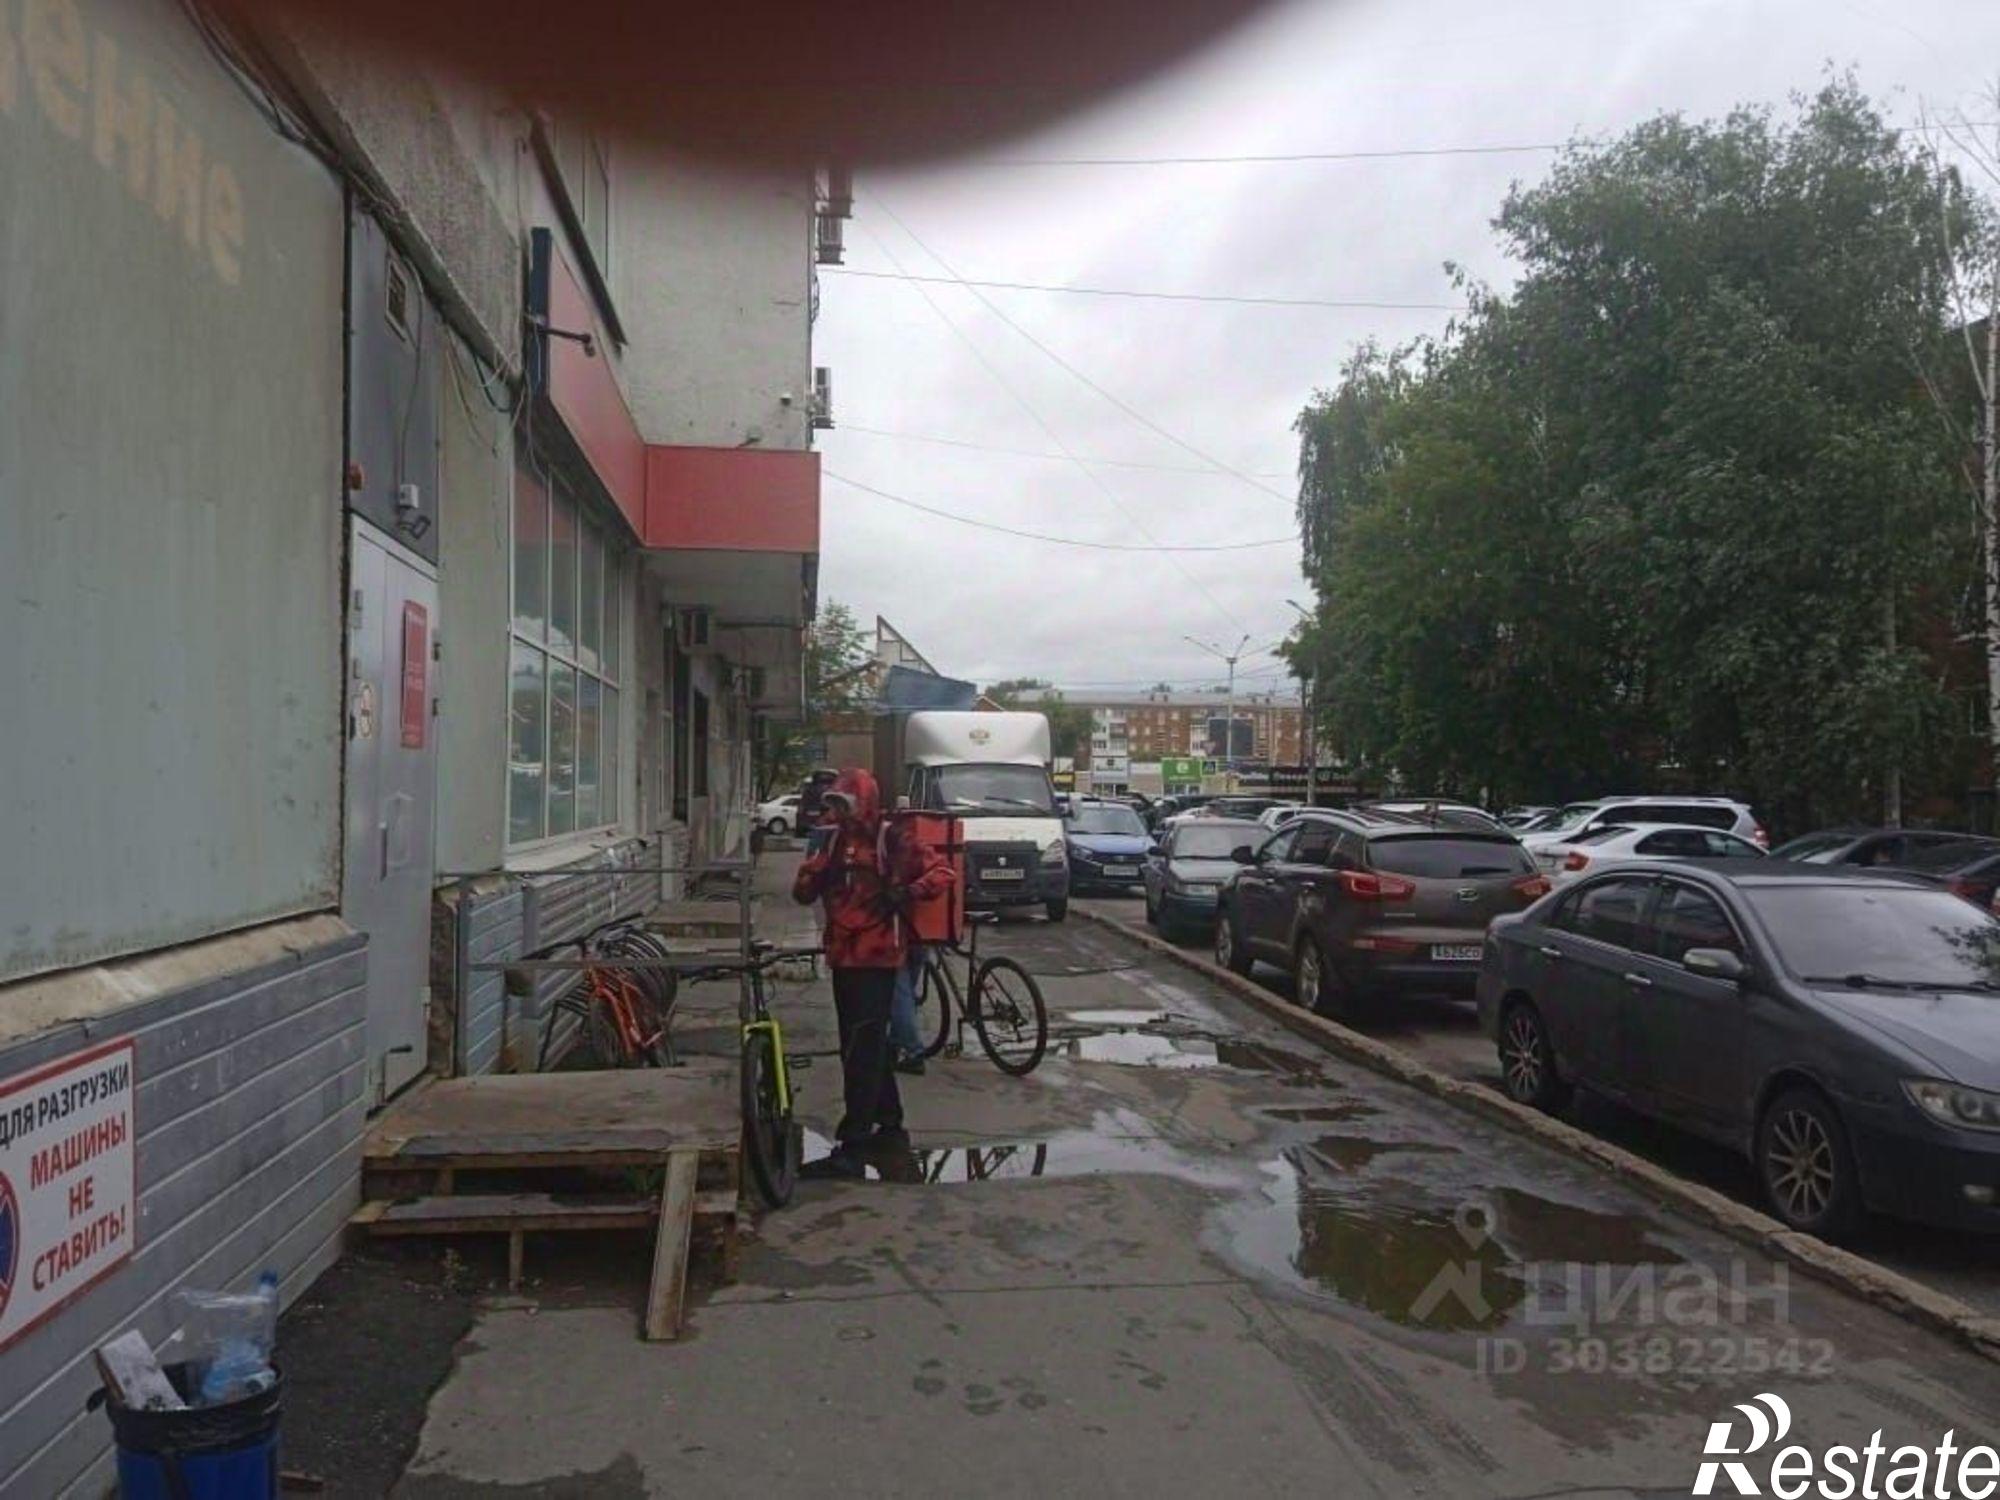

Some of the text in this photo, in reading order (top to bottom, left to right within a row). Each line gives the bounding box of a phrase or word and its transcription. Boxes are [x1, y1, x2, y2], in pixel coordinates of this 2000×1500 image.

[0, 1061, 129, 1148] ДЛЯ РАЗГРУЗКИ
[30, 1111, 127, 1191] МАШИНЫ
[68, 1177, 94, 1219] НЕ
[32, 1204, 126, 1292] СТАВИТЬ!
